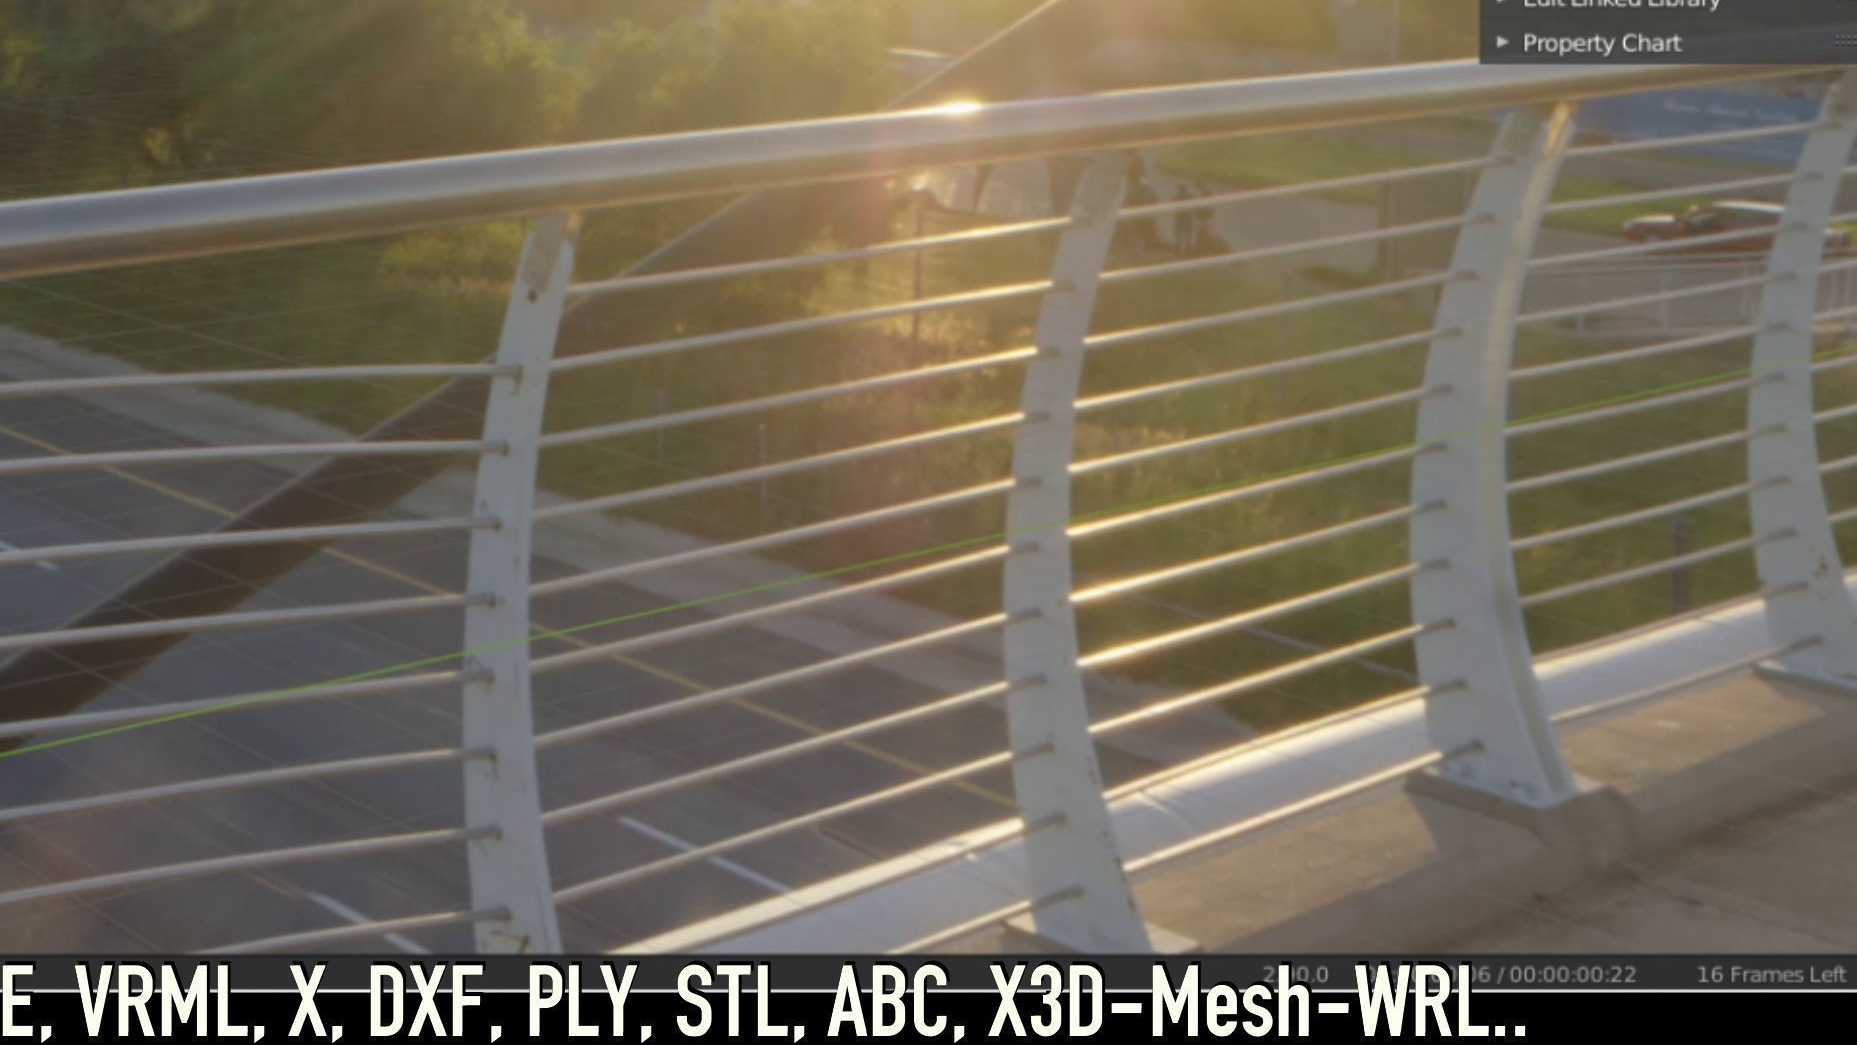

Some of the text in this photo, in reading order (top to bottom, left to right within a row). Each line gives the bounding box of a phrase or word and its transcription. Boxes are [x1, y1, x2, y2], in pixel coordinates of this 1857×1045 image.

[1525, 34, 1681, 56] Property Chart
[1698, 964, 1848, 983] 16 Frames Left
